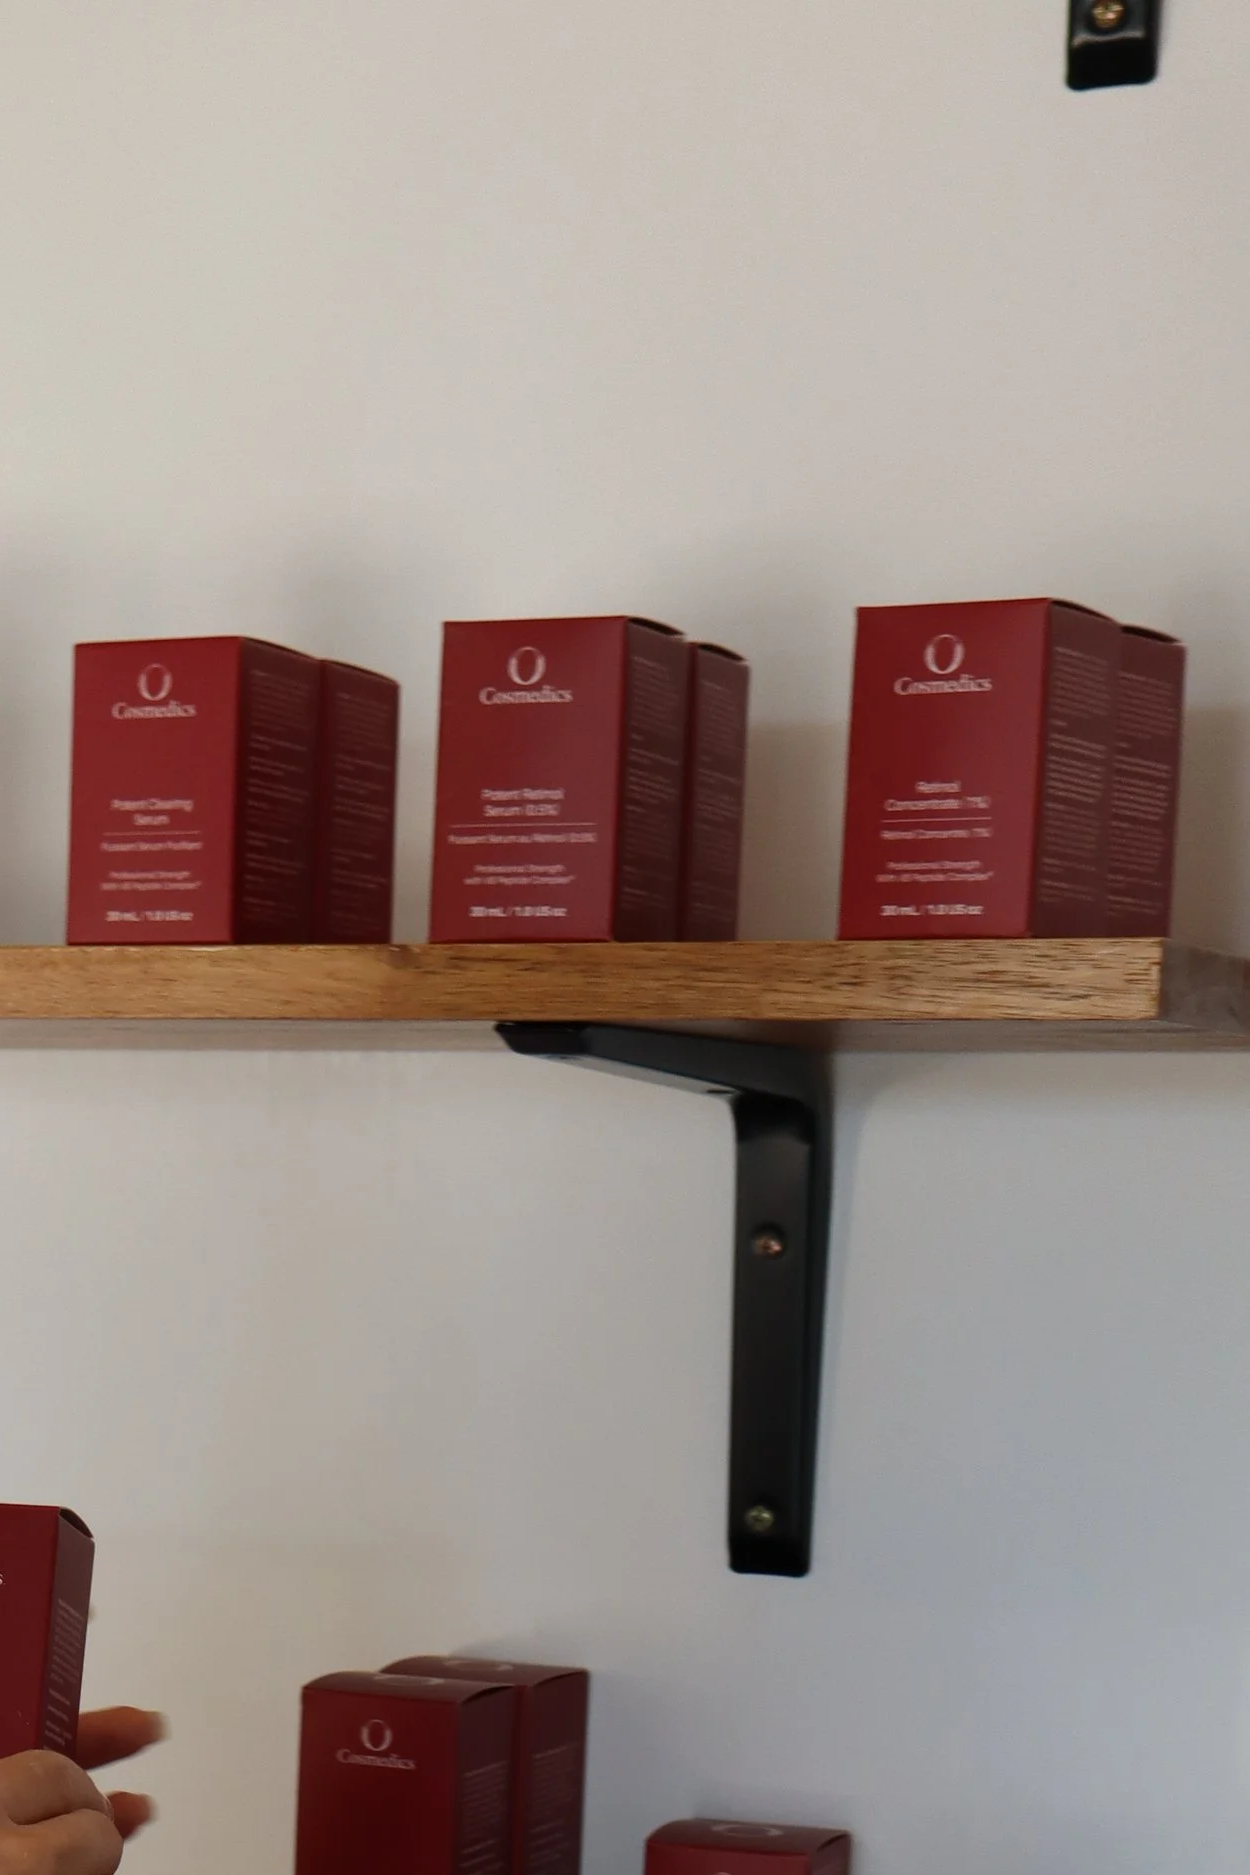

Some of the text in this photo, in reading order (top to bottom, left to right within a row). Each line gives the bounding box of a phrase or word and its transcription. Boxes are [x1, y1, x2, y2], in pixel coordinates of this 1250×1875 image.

[479, 686, 574, 705] Cosmedics
[894, 675, 993, 696] Cosmedics
[111, 700, 197, 719] Cosmedics
[335, 1748, 417, 1770] Cosmedics
